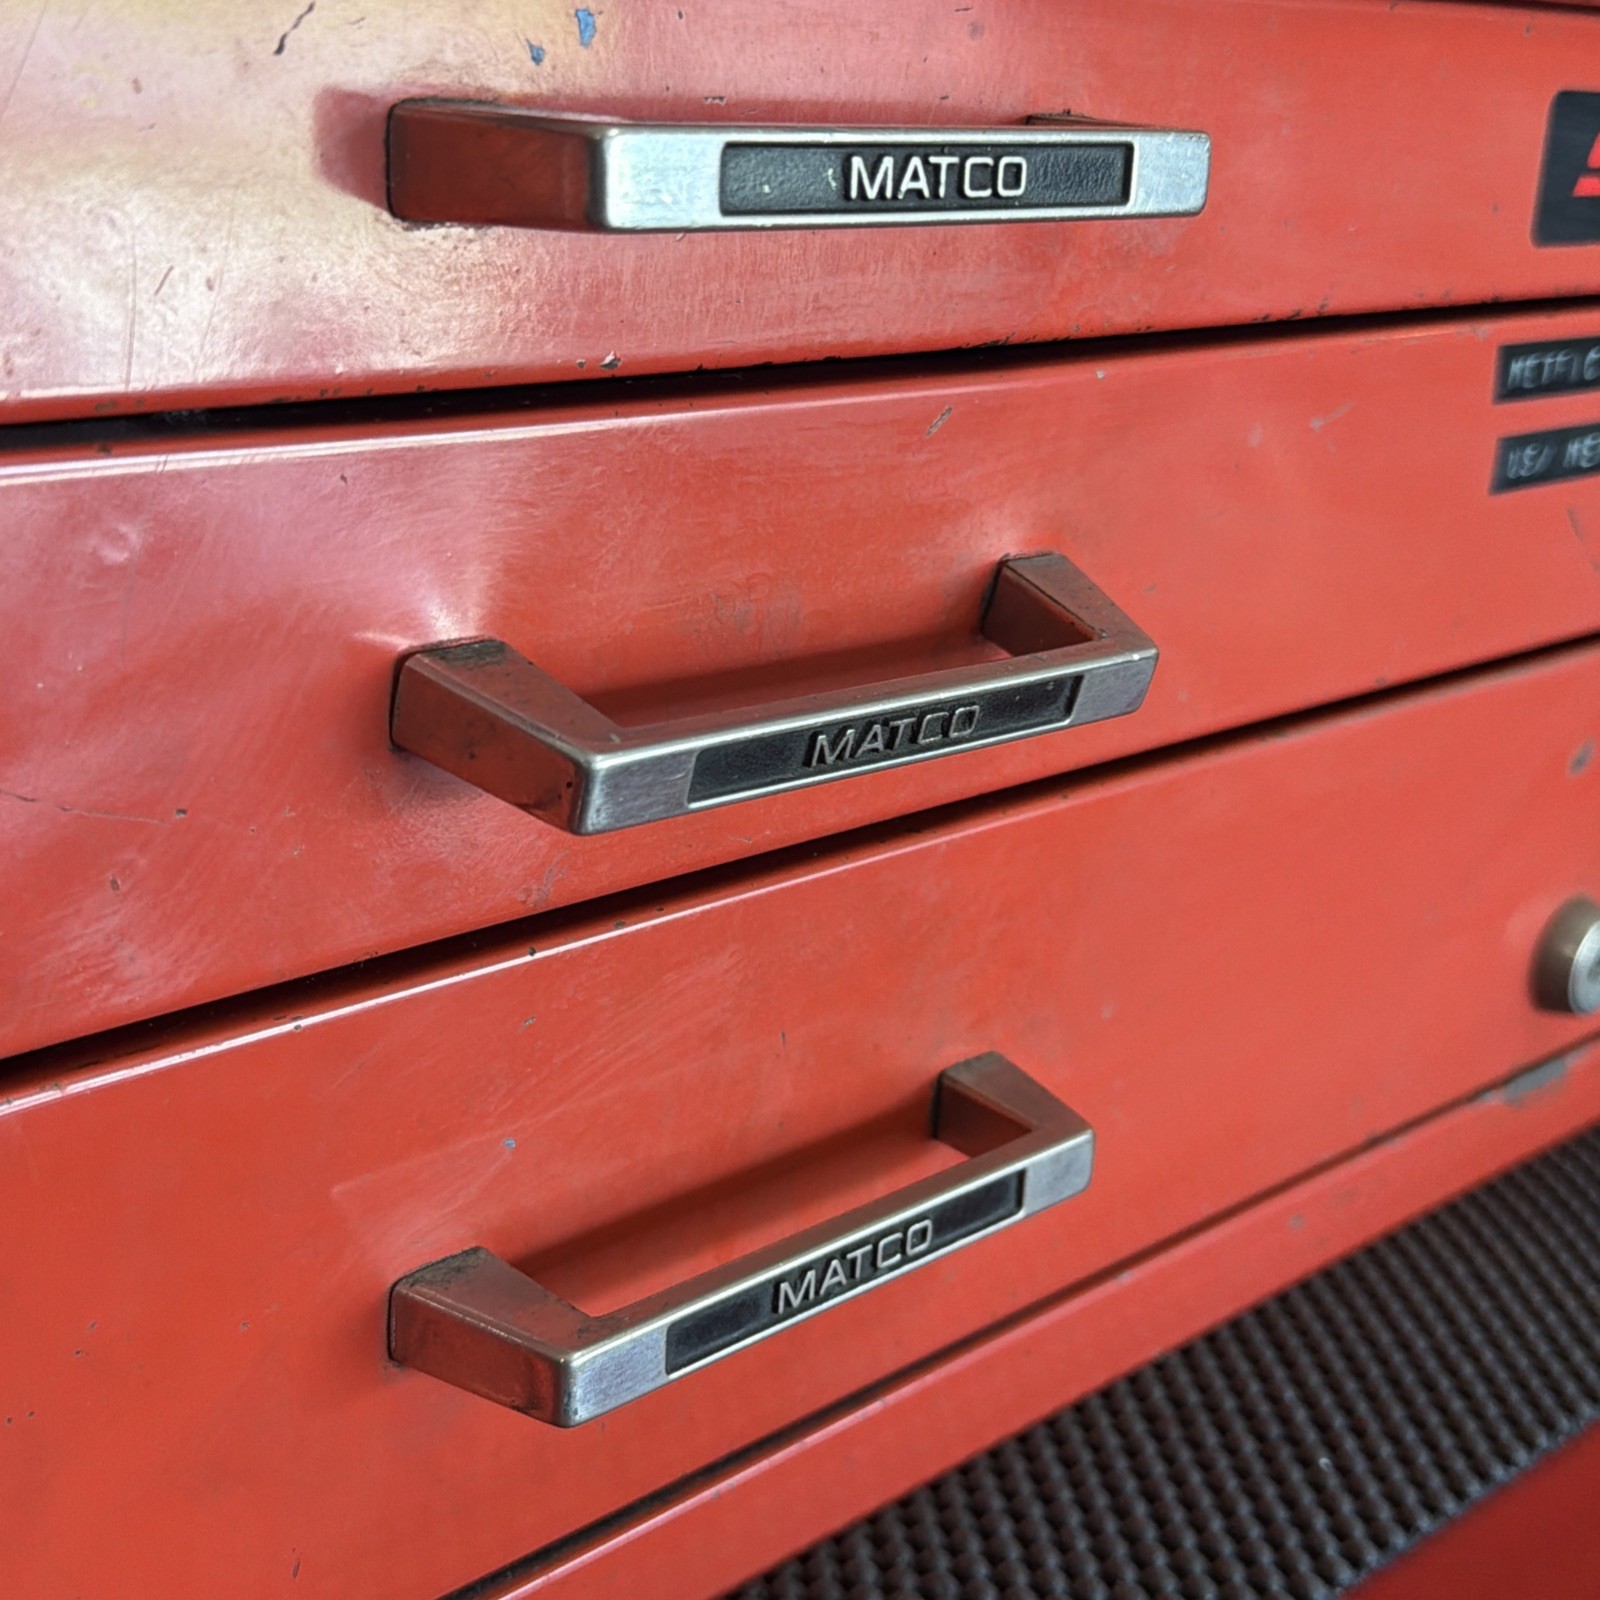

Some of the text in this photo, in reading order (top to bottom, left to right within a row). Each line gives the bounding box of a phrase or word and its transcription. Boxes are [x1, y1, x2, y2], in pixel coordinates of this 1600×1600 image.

[849, 155, 1028, 200] MATCO
[811, 704, 981, 769] MATCO
[777, 1218, 933, 1315] MATCO
